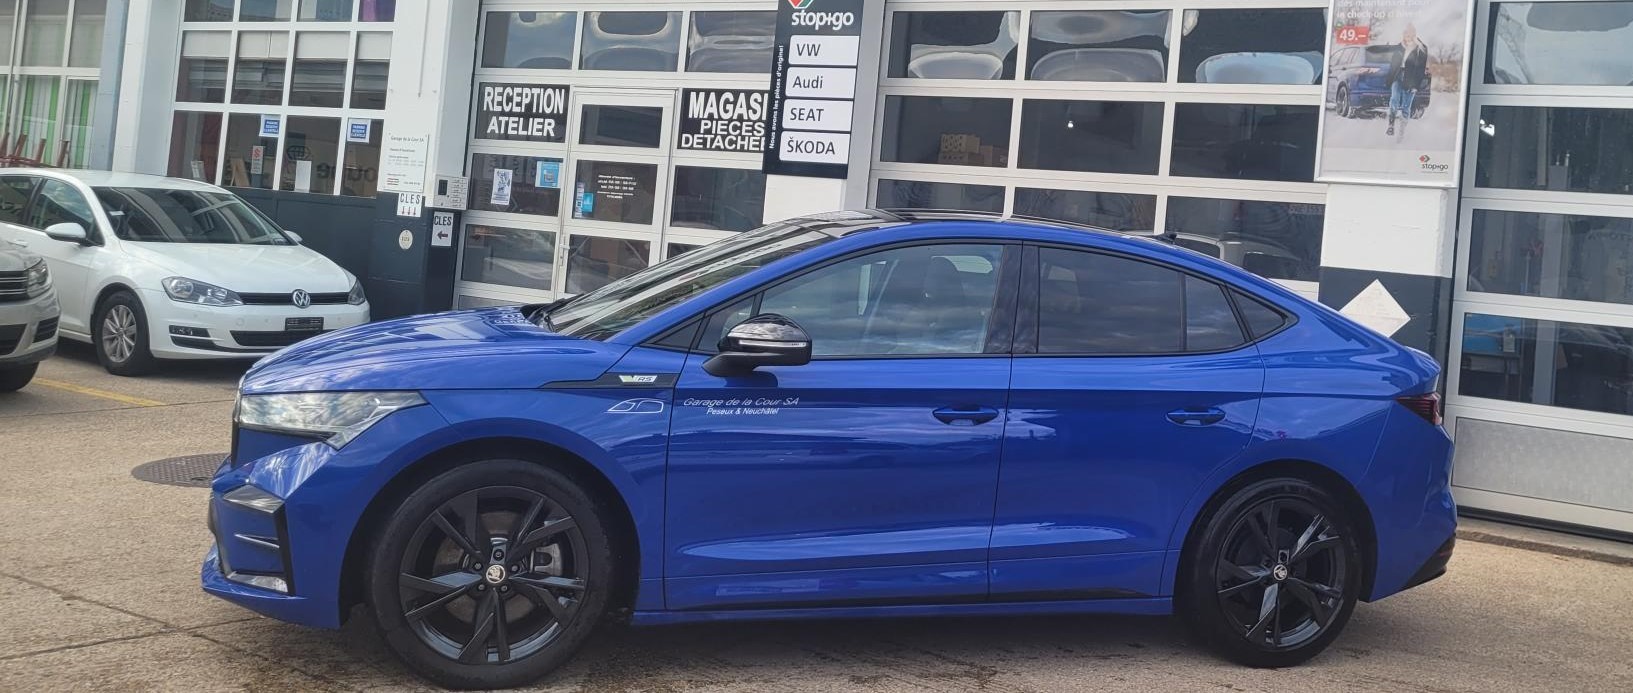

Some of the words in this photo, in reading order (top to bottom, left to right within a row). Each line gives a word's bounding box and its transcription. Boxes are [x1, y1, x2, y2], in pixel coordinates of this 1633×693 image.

[791, 9, 854, 30] stop+go
[796, 43, 821, 56] VW
[792, 75, 824, 89] Audi
[483, 86, 565, 114] RECEPTION
[790, 108, 824, 122] SEAT
[486, 116, 555, 137] ATELIER
[700, 120, 765, 136] PIECES
[787, 136, 835, 155] ŠKODA
[400, 193, 420, 205] CLES
[433, 215, 452, 226] CLES
[683, 397, 724, 407] Garage
[725, 398, 740, 406] de
[741, 398, 753, 406] la
[755, 397, 782, 406] Cour
[782, 397, 800, 406] SA
[706, 407, 734, 415] Peseux
[735, 407, 741, 415] &
[742, 406, 780, 415] Neuchâtel
